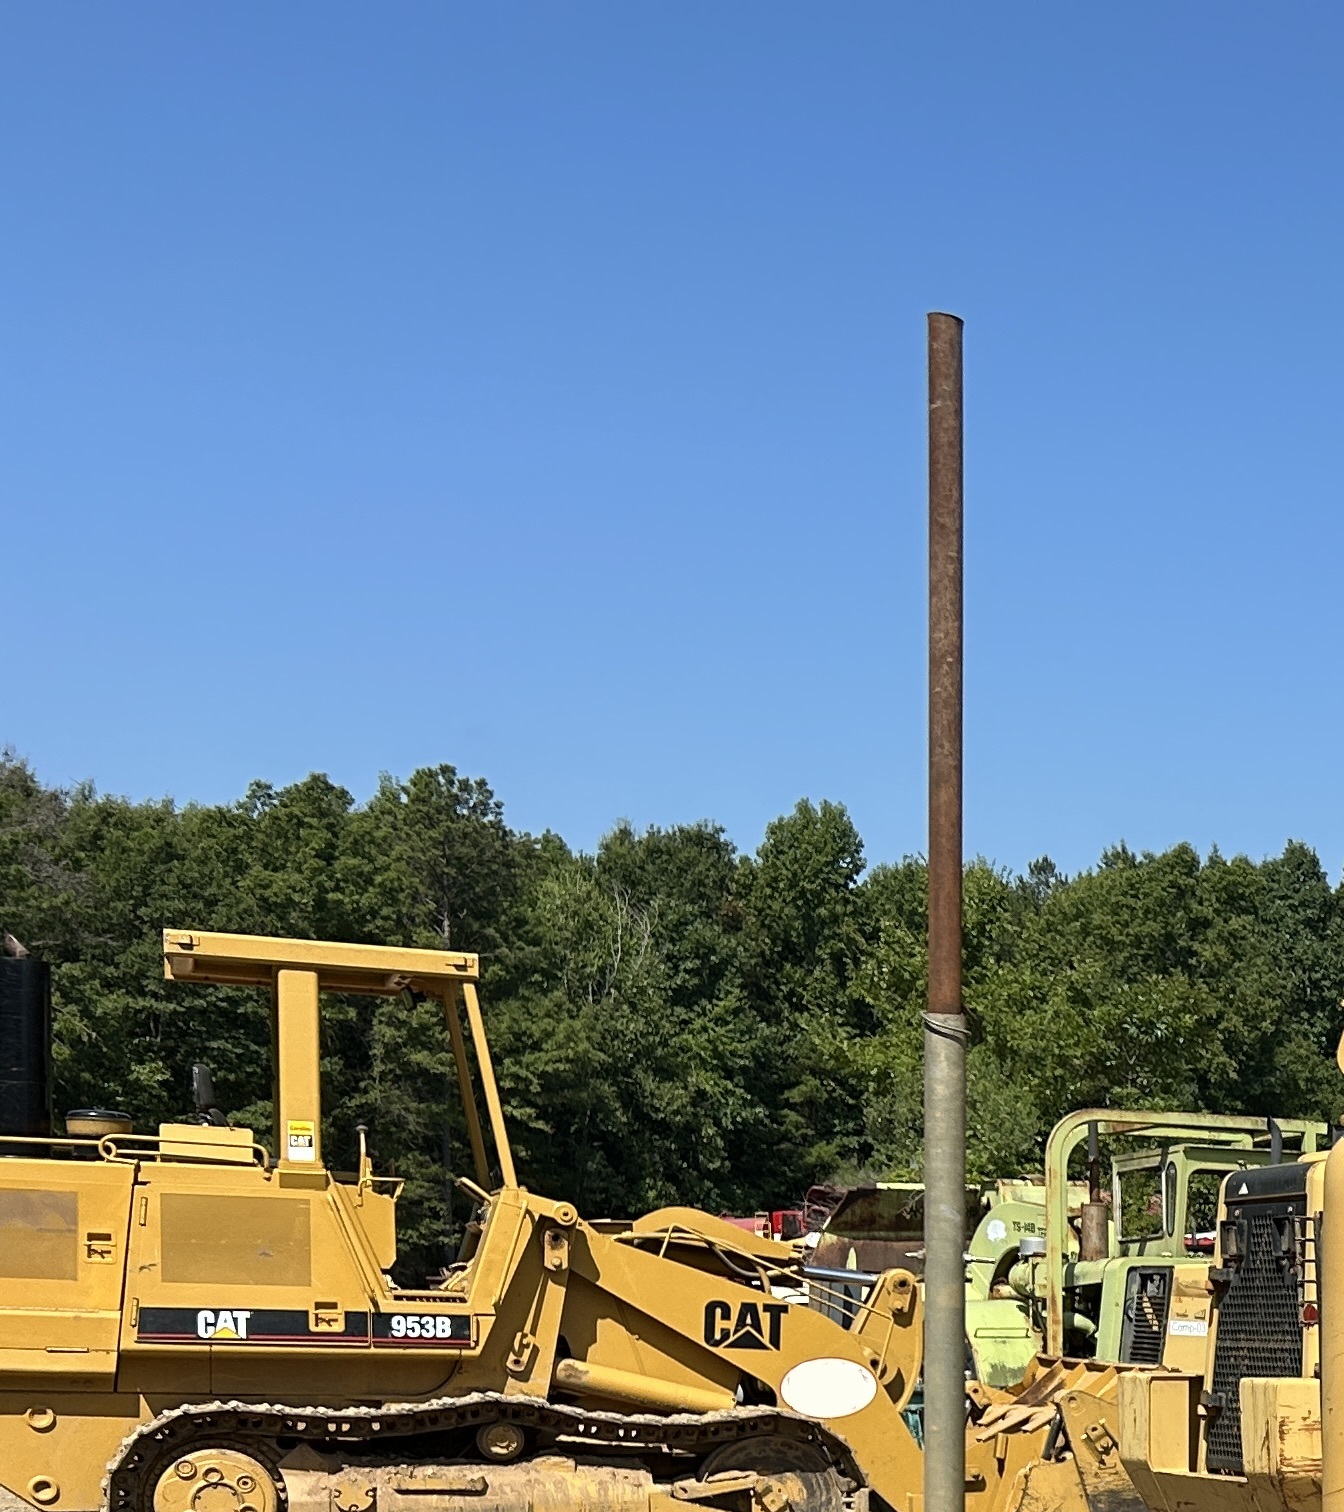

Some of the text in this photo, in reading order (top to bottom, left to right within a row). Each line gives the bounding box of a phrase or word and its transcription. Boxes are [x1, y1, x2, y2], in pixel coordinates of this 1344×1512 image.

[197, 1310, 250, 1339] CAT
[391, 1316, 451, 1338] 953B
[704, 1300, 789, 1351] CAT
